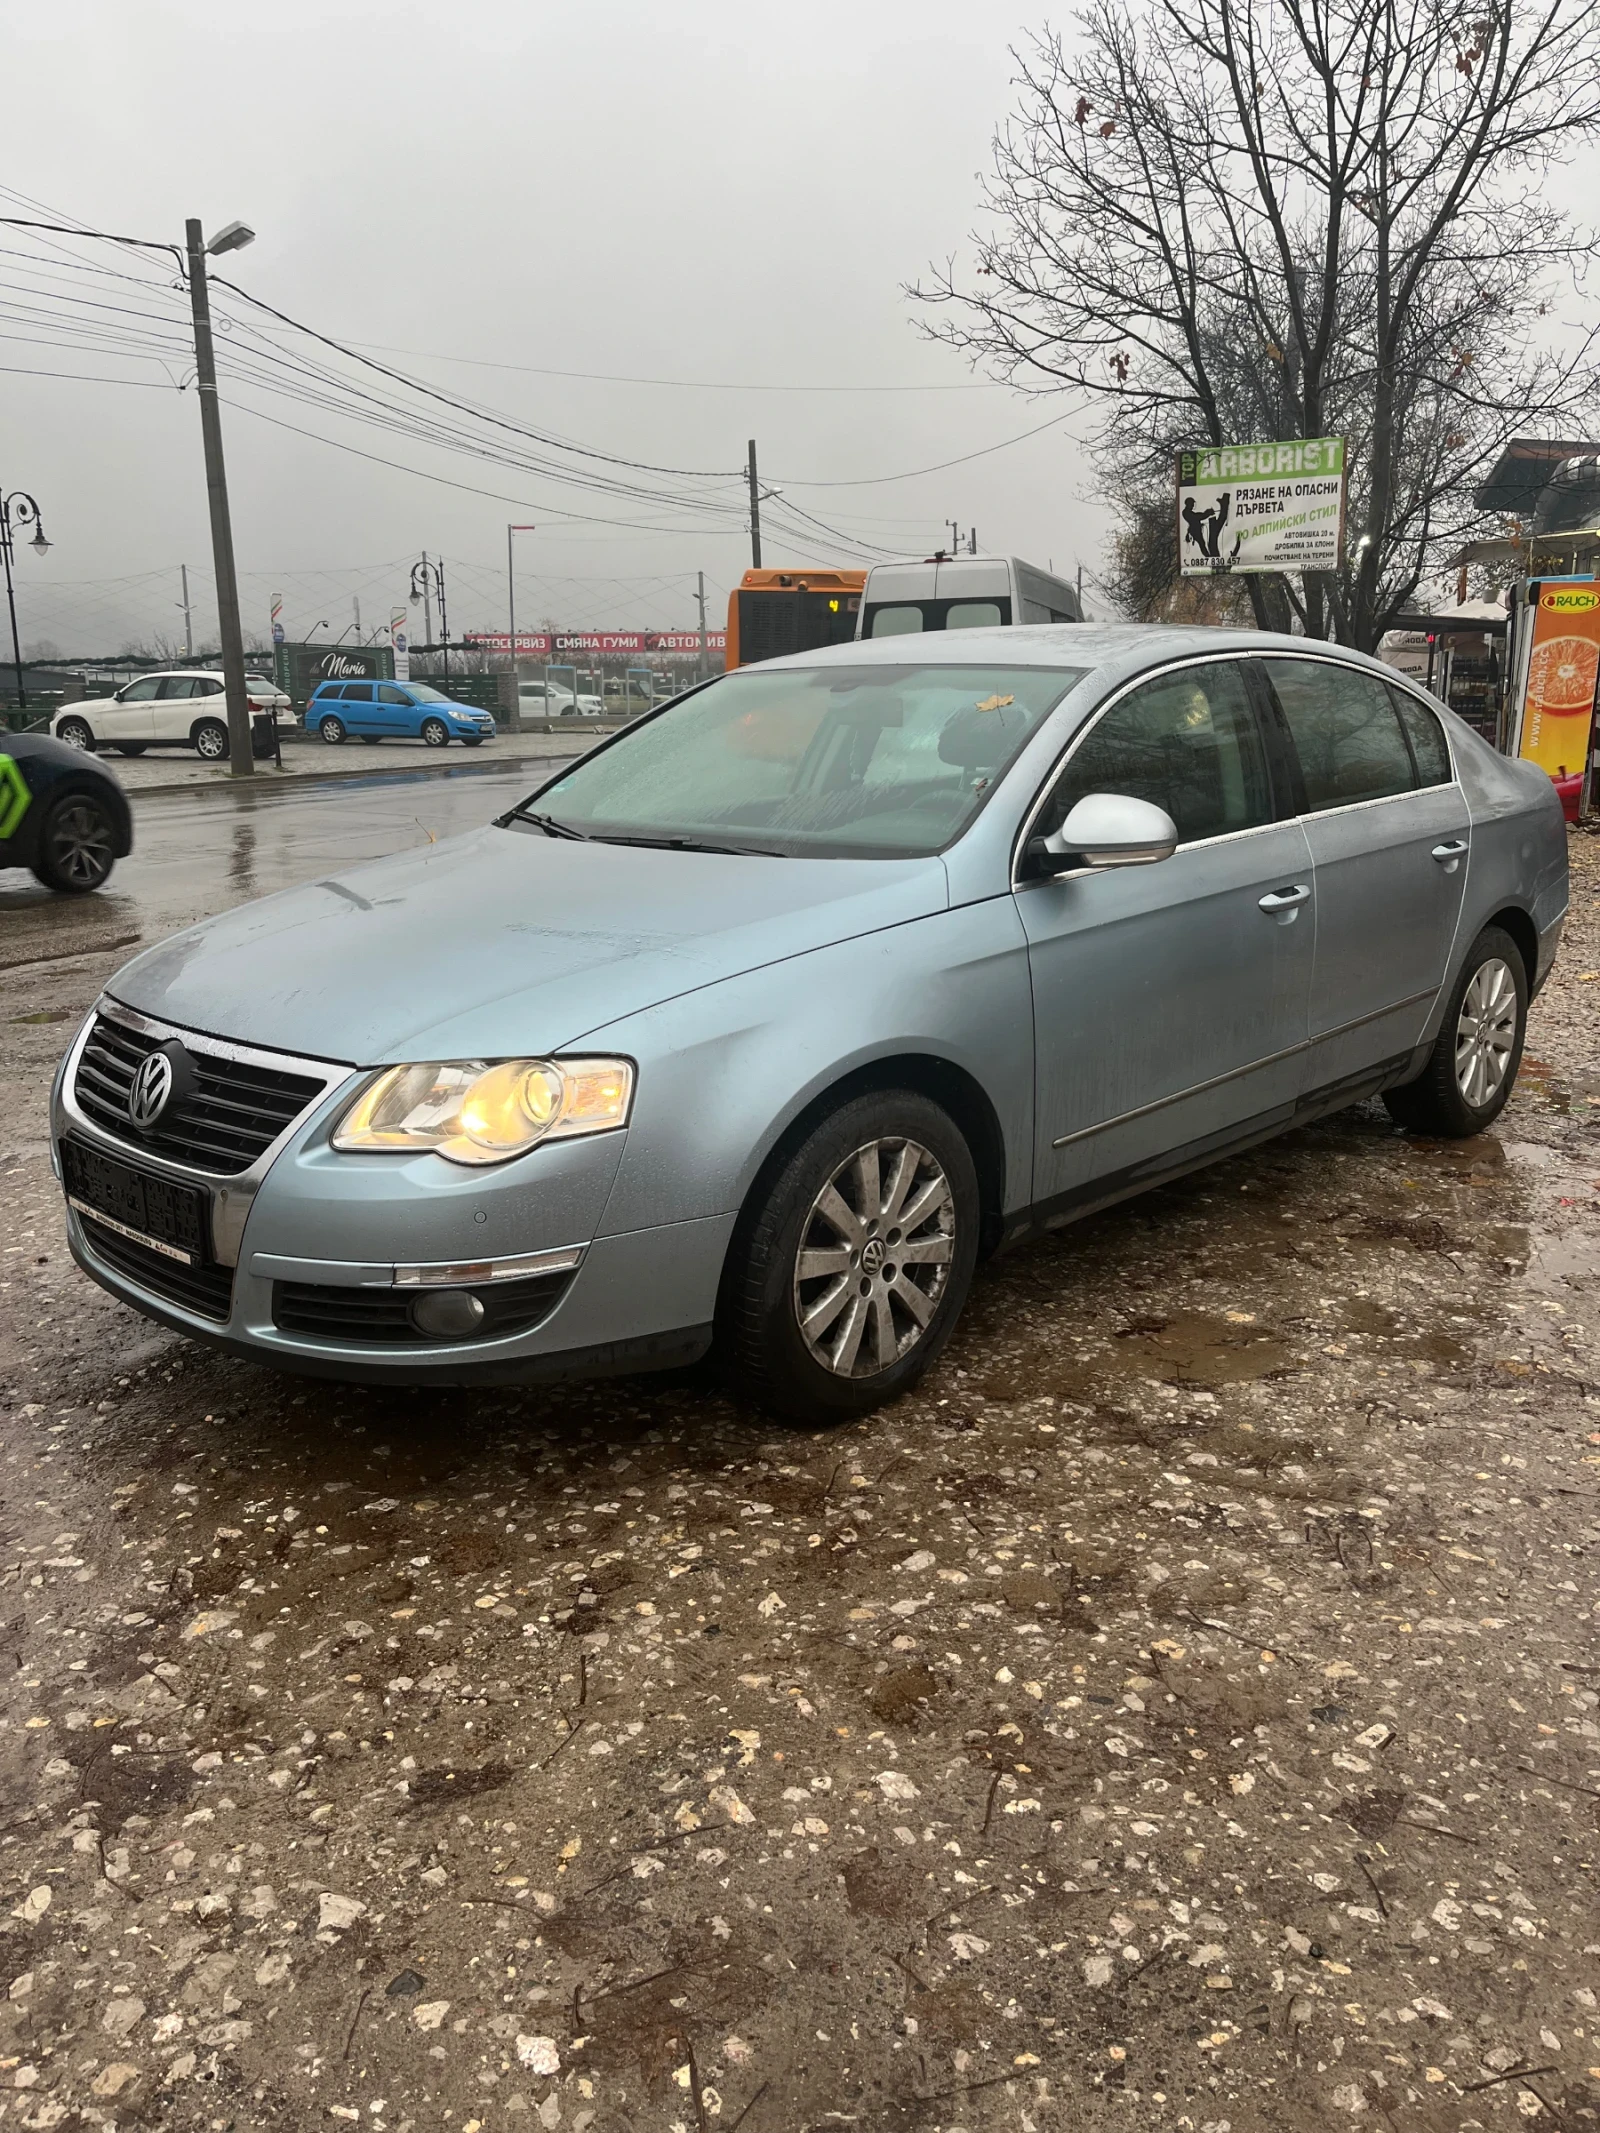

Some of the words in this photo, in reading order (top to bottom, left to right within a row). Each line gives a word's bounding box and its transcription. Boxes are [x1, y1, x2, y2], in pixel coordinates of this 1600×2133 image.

[1182, 453, 1194, 480] TOP
[1200, 441, 1340, 479] ARBORIST
[1236, 486, 1275, 501] РЯЗАНЕ
[1278, 485, 1292, 498] НА
[1295, 482, 1338, 497] ОПАСНИ
[1236, 502, 1284, 517] ДЪРВЕТА
[1235, 528, 1249, 541] ПО
[1252, 513, 1306, 537] АЛПИЙСКИ
[1309, 504, 1337, 521] СТИЛ
[1284, 530, 1319, 539] АВТОВИШКА
[1275, 542, 1305, 551] ДРОБИЛКА
[1190, 558, 1209, 567] 0887
[1211, 557, 1225, 566] 830
[1227, 557, 1241, 565] 457
[1264, 553, 1301, 561] ПОЧИСТВАНЕ
[1312, 551, 1335, 559] ТЕРЕНИ
[1300, 562, 1334, 570] ТРАНСПОРТ
[1556, 596, 1595, 607] RAUCH
[556, 637, 600, 648] СМЯНА
[603, 637, 638, 648] ГУМИ
[321, 652, 367, 679] Maria
[1530, 650, 1550, 747] www.rauch.cc
